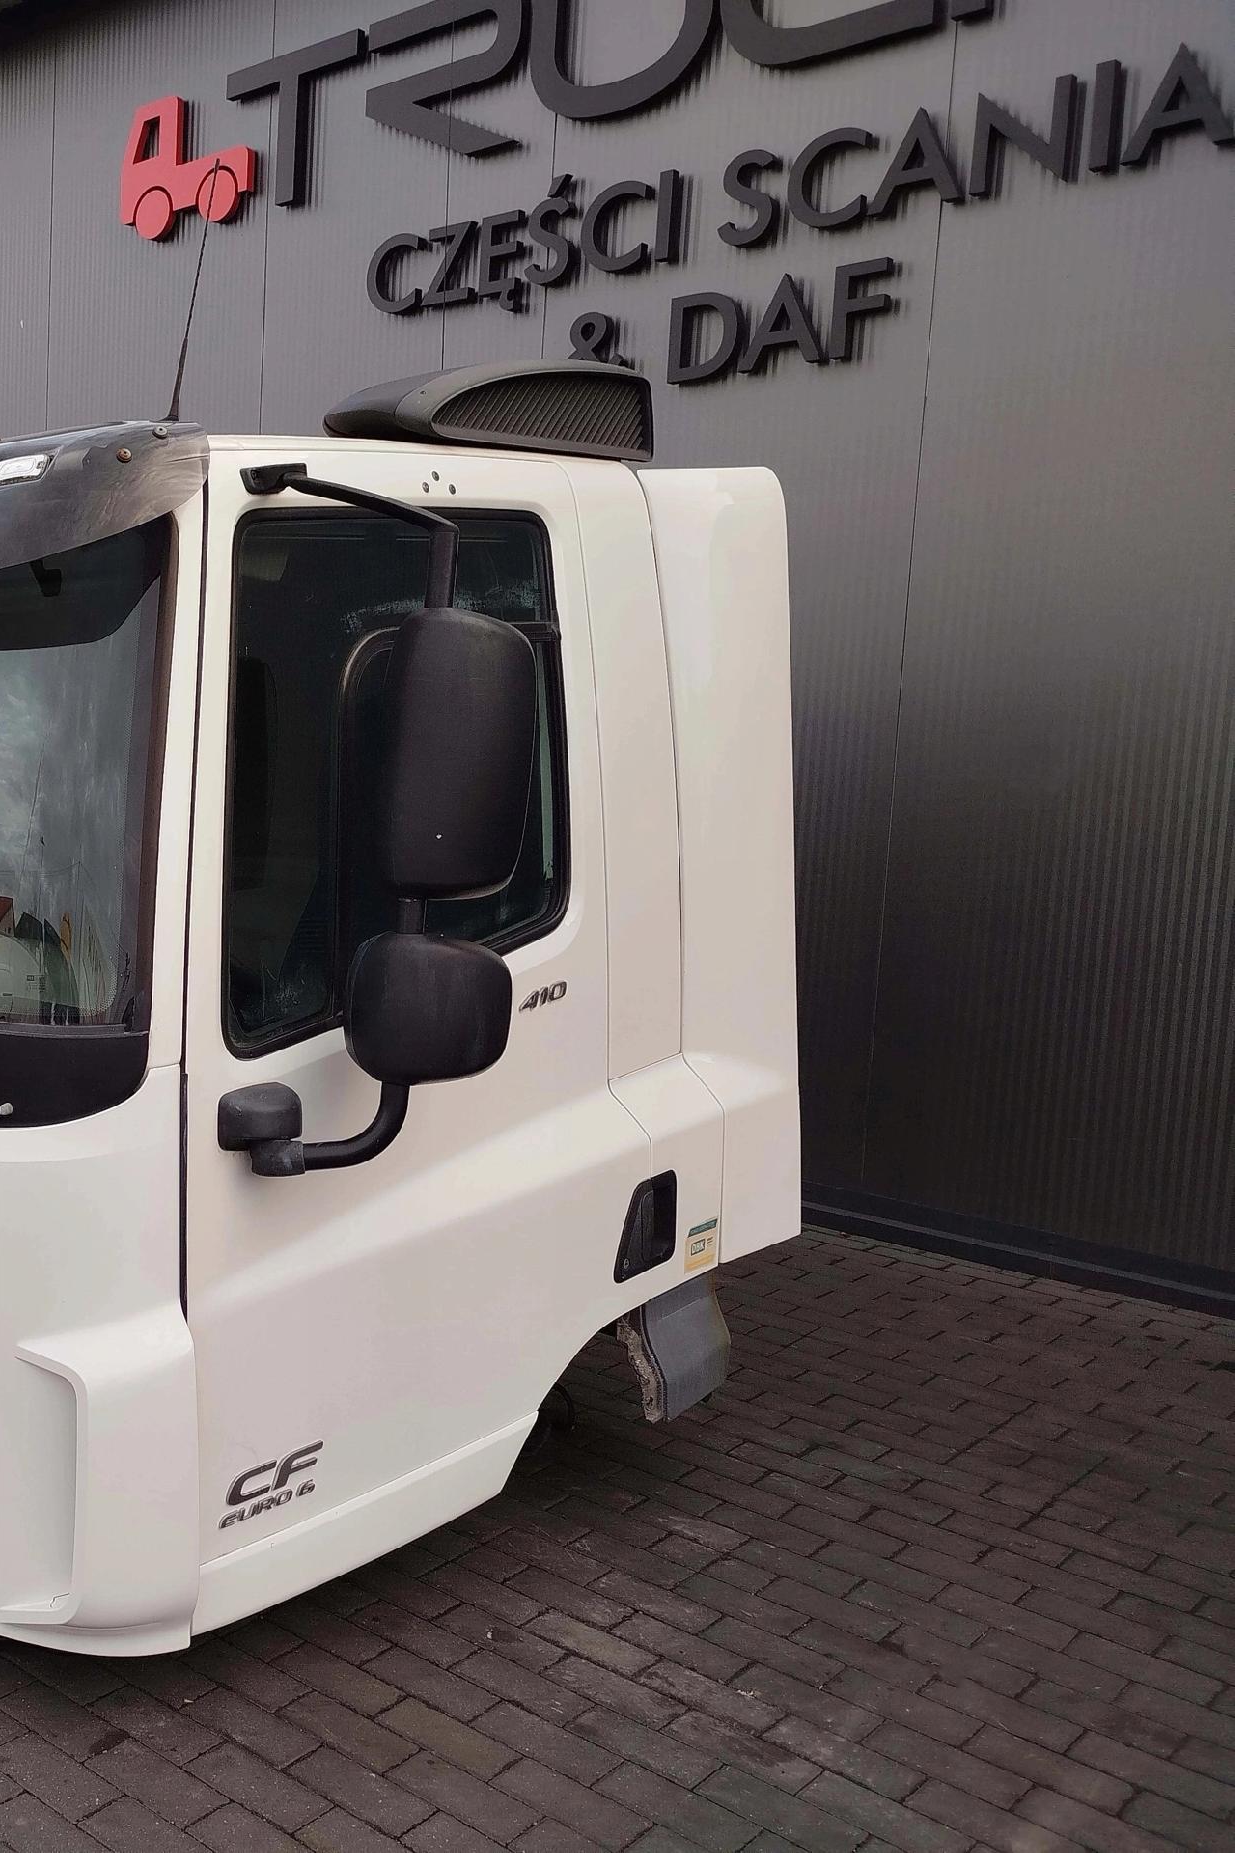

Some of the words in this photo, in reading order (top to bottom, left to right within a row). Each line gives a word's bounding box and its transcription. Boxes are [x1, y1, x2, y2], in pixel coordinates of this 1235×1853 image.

[227, 0, 994, 206] TRU
[367, 170, 680, 315] CZĘŚCI
[718, 42, 1234, 248] SCANIA
[568, 312, 626, 362] &
[667, 256, 895, 385] DAF
[519, 981, 567, 1013] 410
[218, 1488, 292, 1530] EURO
[296, 1479, 316, 1497] 6
[226, 1440, 324, 1506] CF
